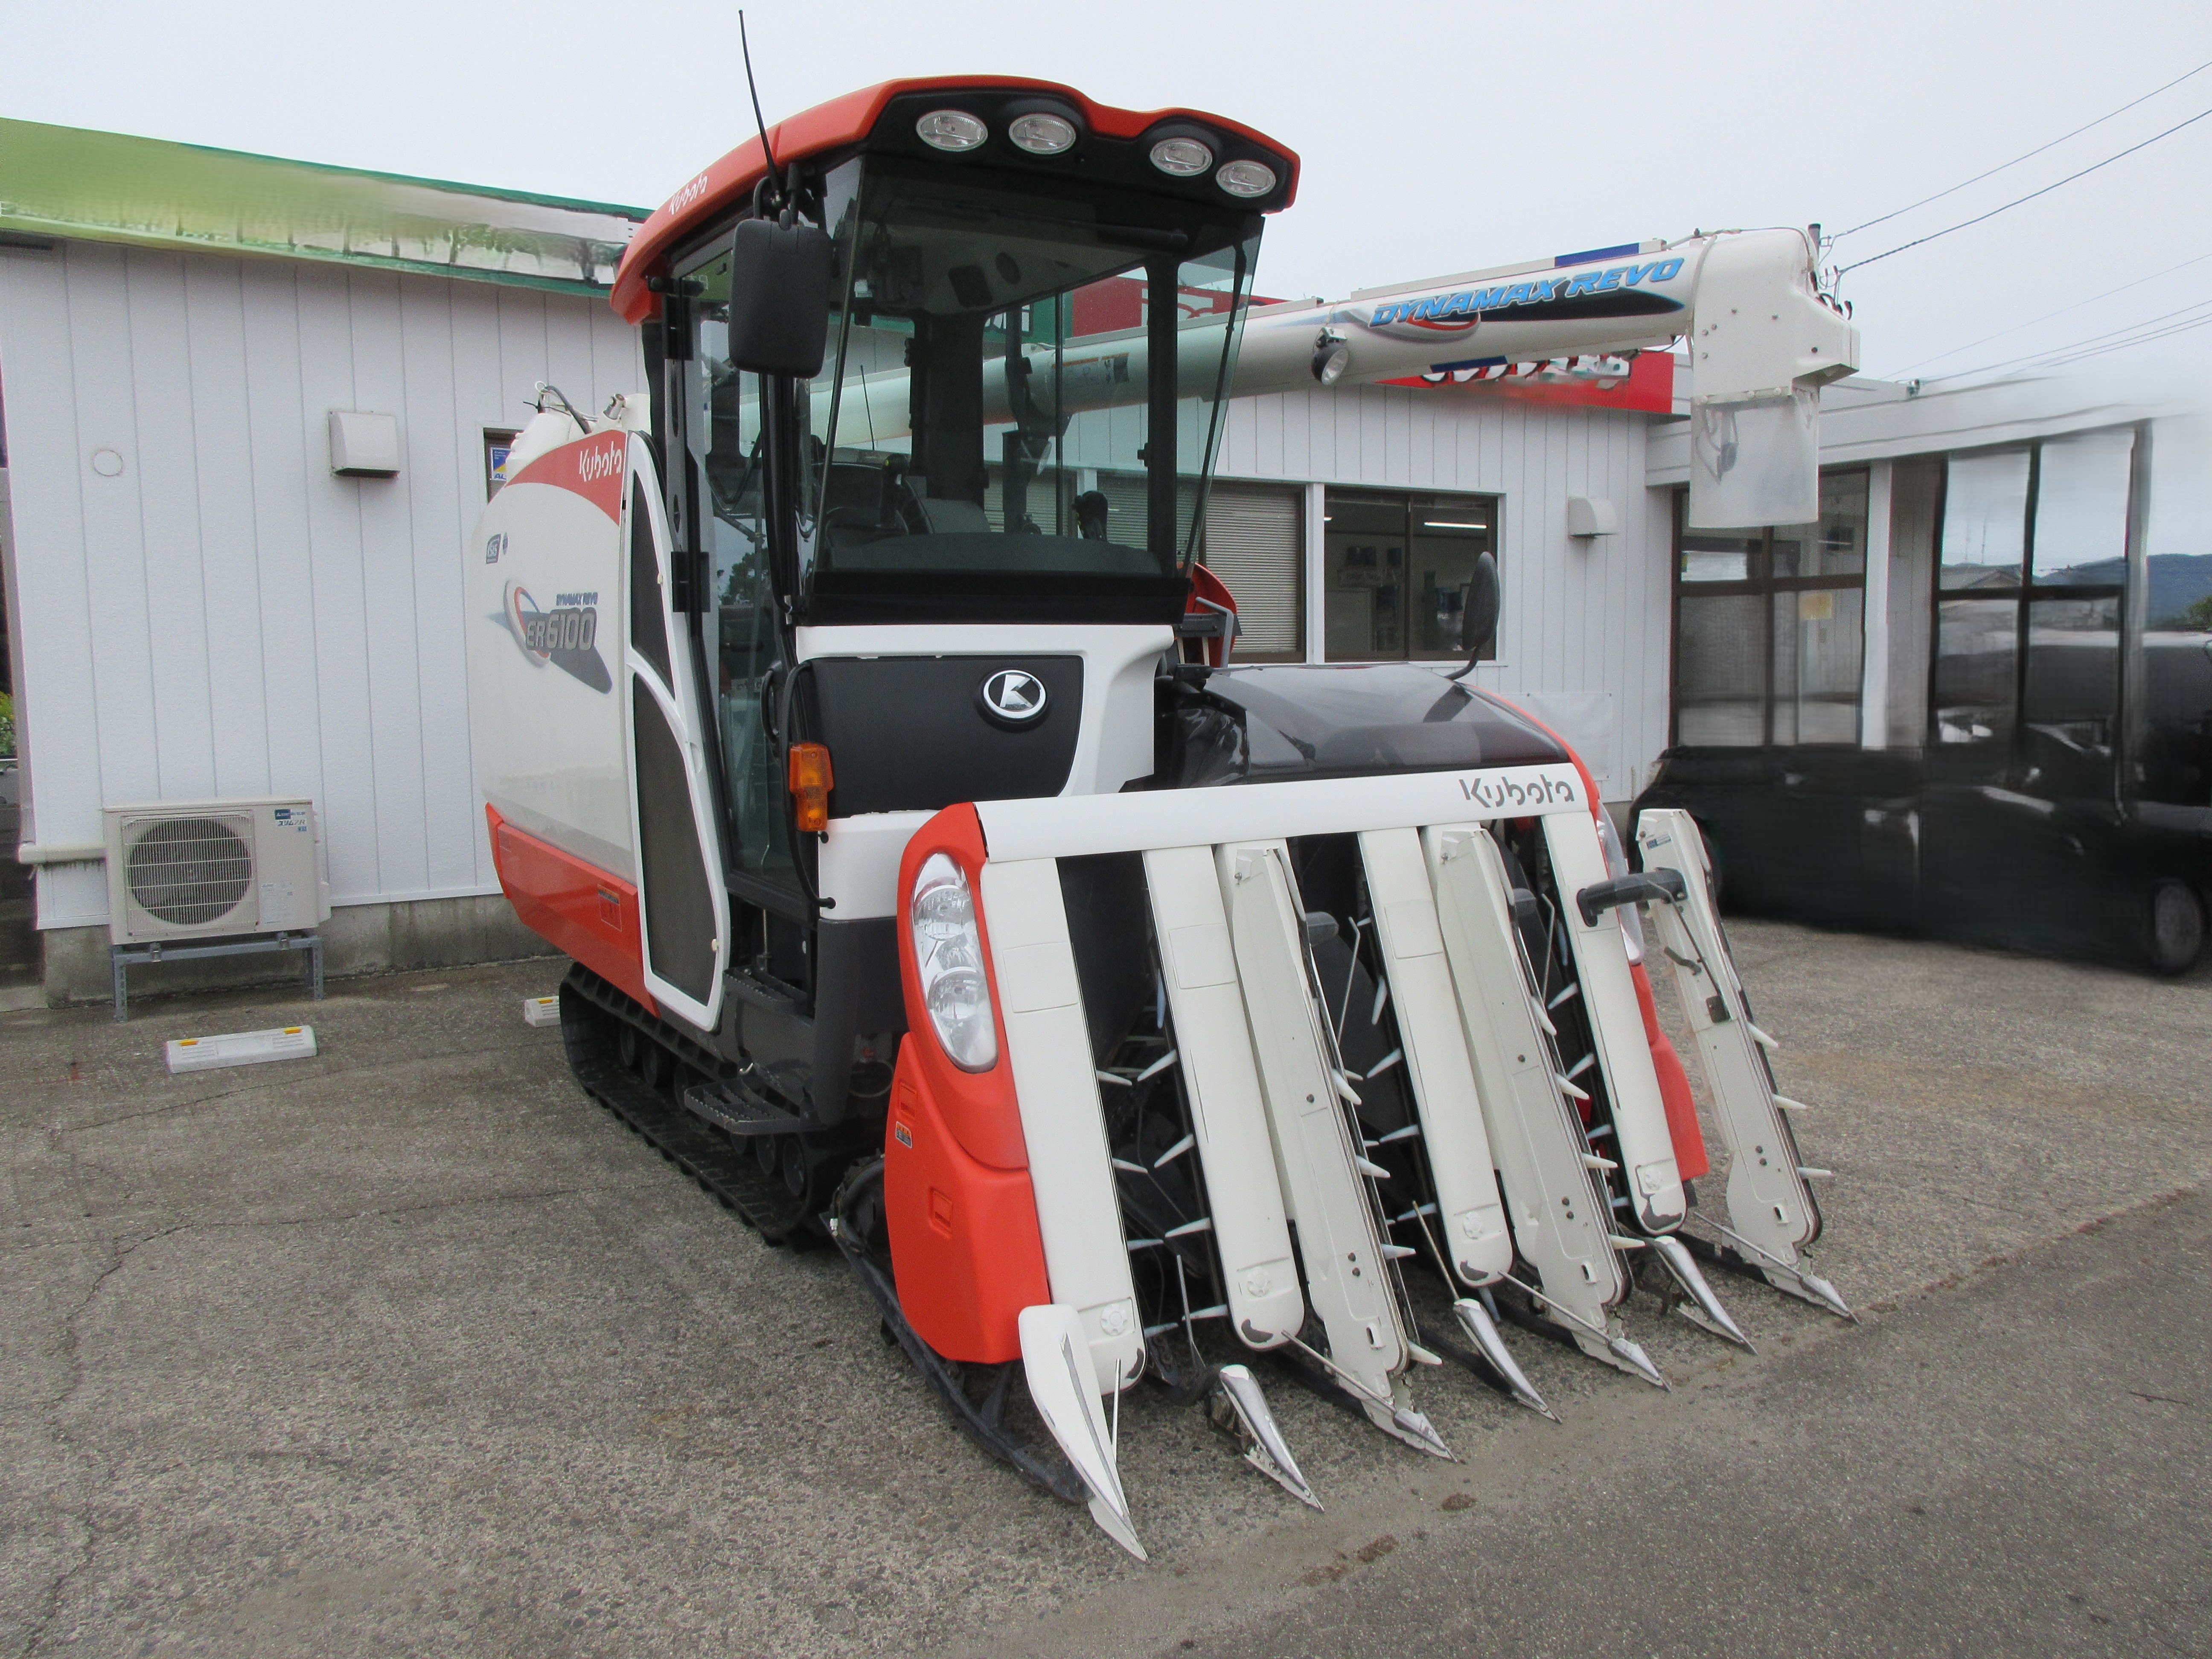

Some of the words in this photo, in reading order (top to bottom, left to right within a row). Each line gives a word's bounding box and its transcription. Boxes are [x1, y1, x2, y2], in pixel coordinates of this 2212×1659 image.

[668, 173, 708, 215] Kubota
[1368, 275, 1569, 328] DYNAMAX
[1564, 257, 1685, 297] REVO
[579, 440, 623, 482] Kubota
[1458, 773, 1575, 808] Kubota
